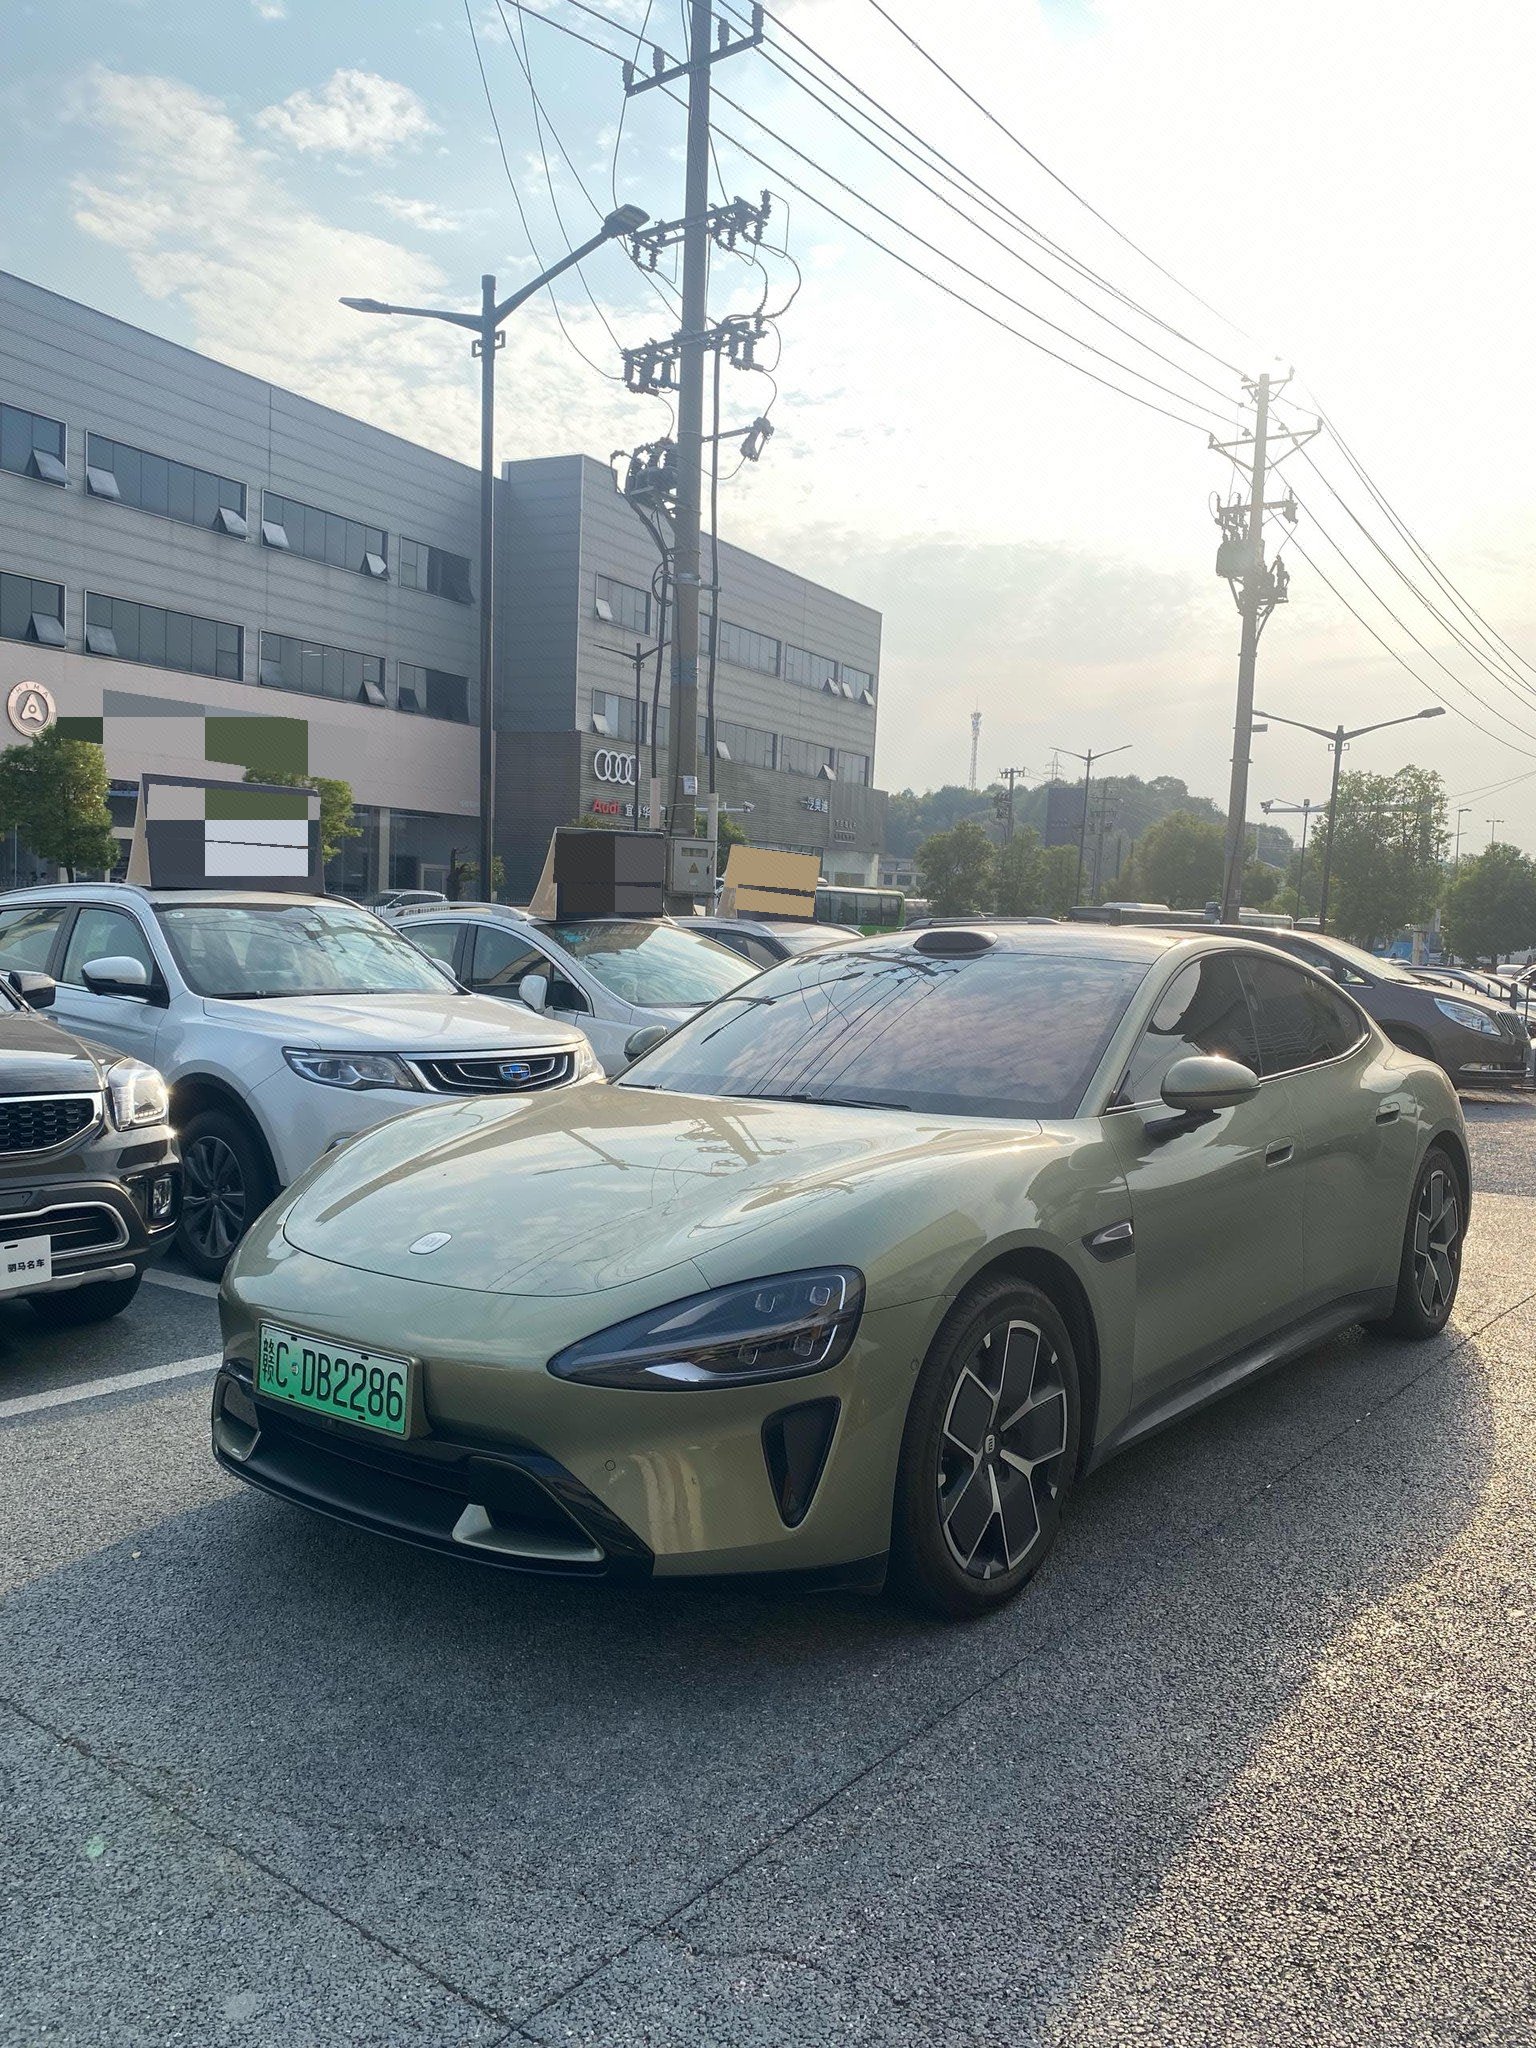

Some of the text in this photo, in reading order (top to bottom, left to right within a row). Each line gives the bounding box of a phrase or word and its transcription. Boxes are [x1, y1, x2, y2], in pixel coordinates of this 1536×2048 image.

[593, 799, 619, 815] Audi
[800, 797, 829, 813] 一汽奥迪
